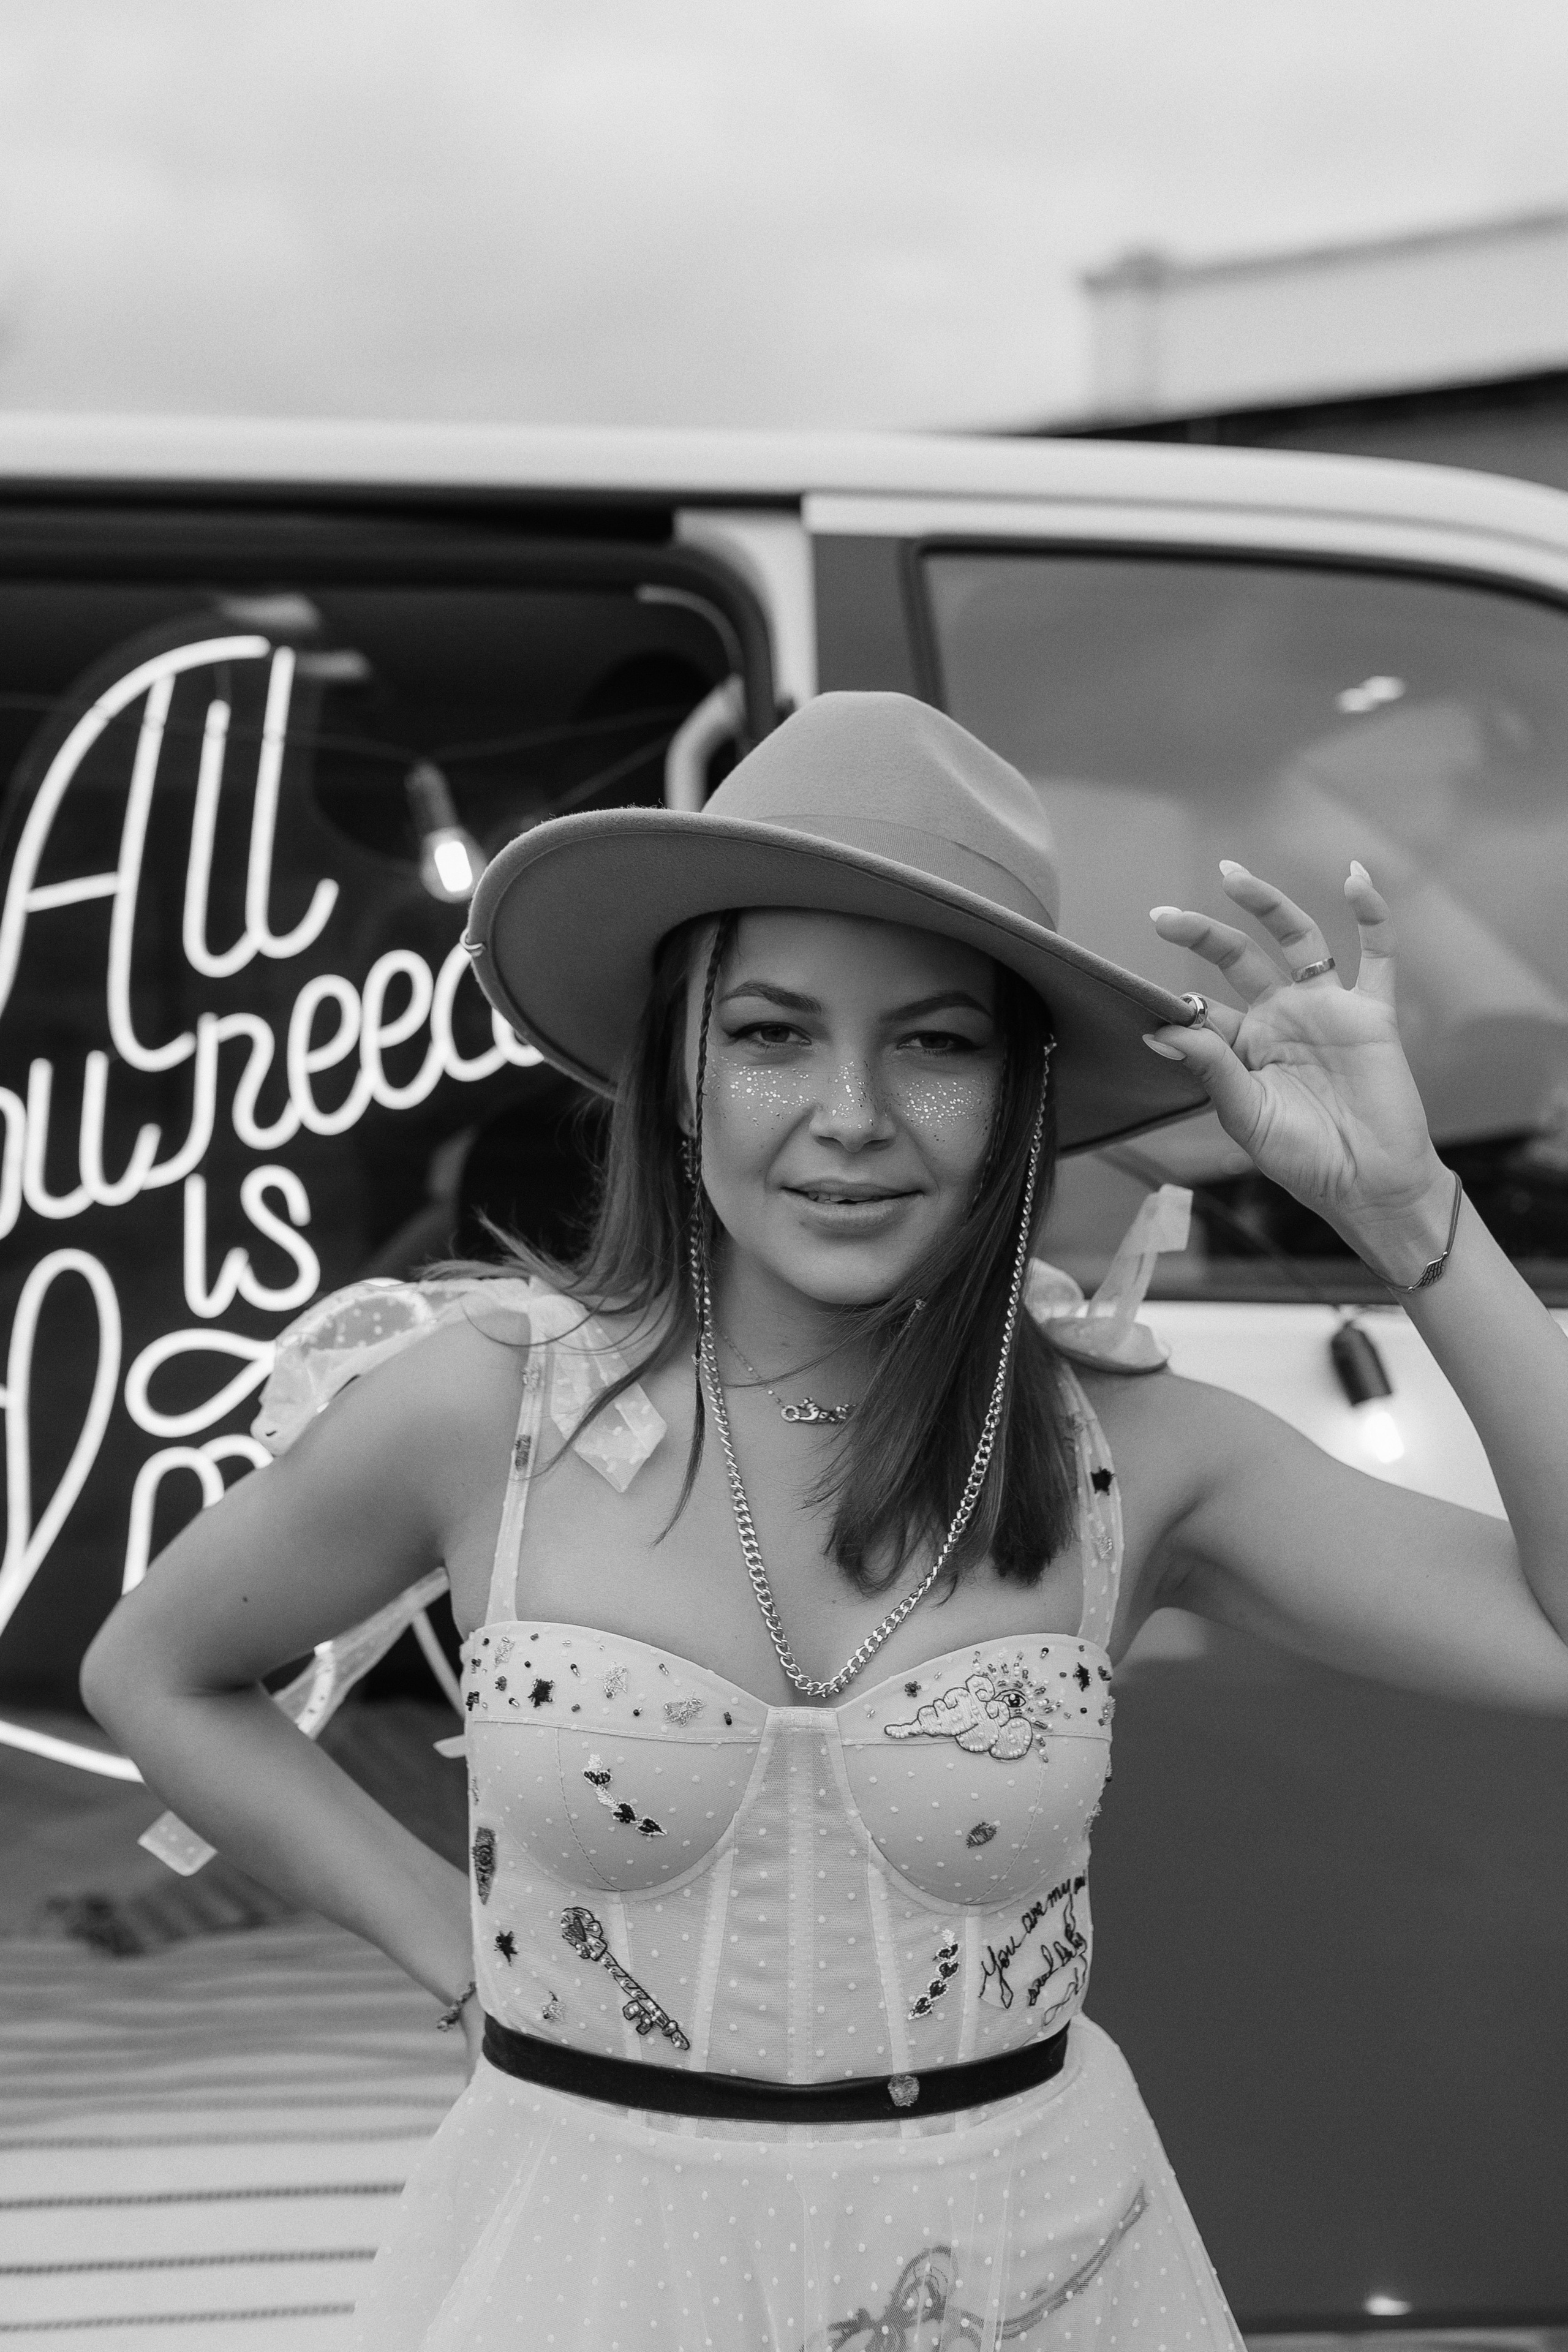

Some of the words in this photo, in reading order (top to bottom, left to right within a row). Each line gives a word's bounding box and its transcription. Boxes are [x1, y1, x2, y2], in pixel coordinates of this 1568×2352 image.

[0, 635, 341, 1073] All
[184, 1163, 321, 1319] is
[979, 1936, 1020, 2010] You
[1021, 1901, 1045, 1934] are
